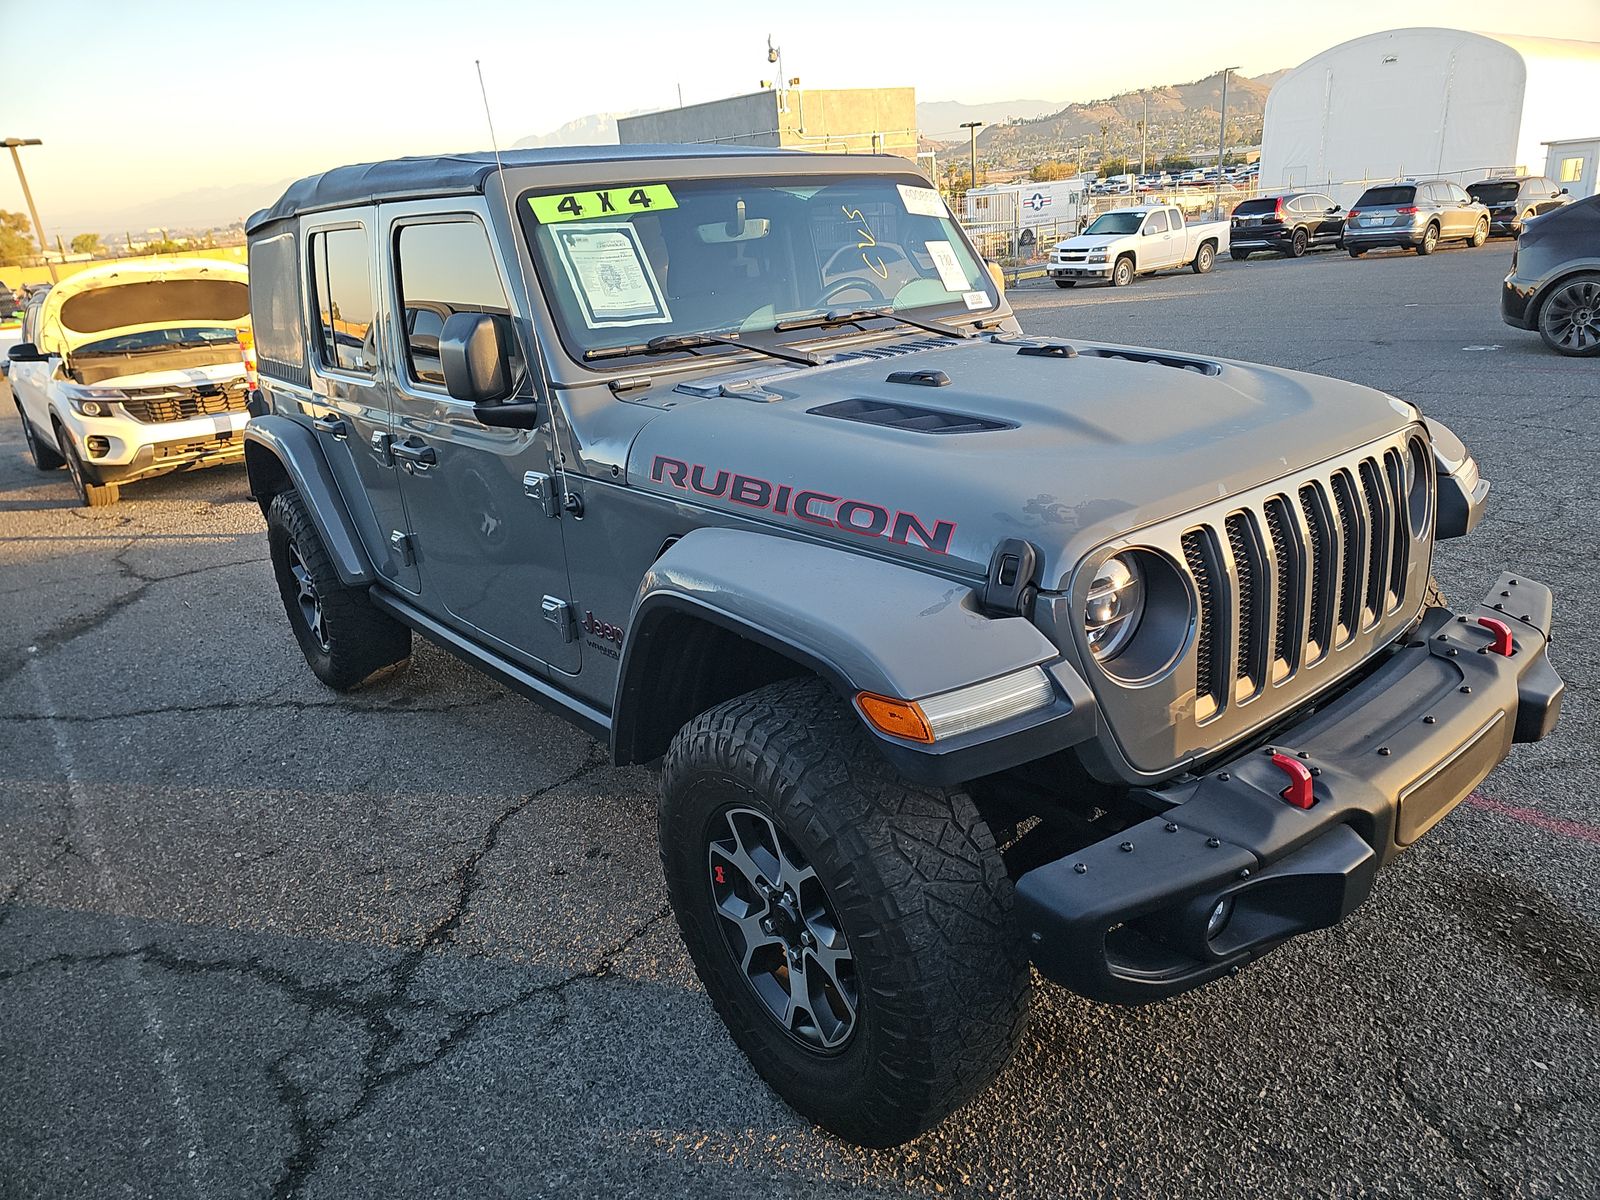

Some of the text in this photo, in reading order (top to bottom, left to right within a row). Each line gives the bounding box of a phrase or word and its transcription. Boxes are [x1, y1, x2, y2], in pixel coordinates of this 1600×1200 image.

[557, 196, 584, 216] 4
[628, 189, 653, 209] 4
[650, 455, 958, 554] RUBICON
[581, 610, 624, 650] Jeep
